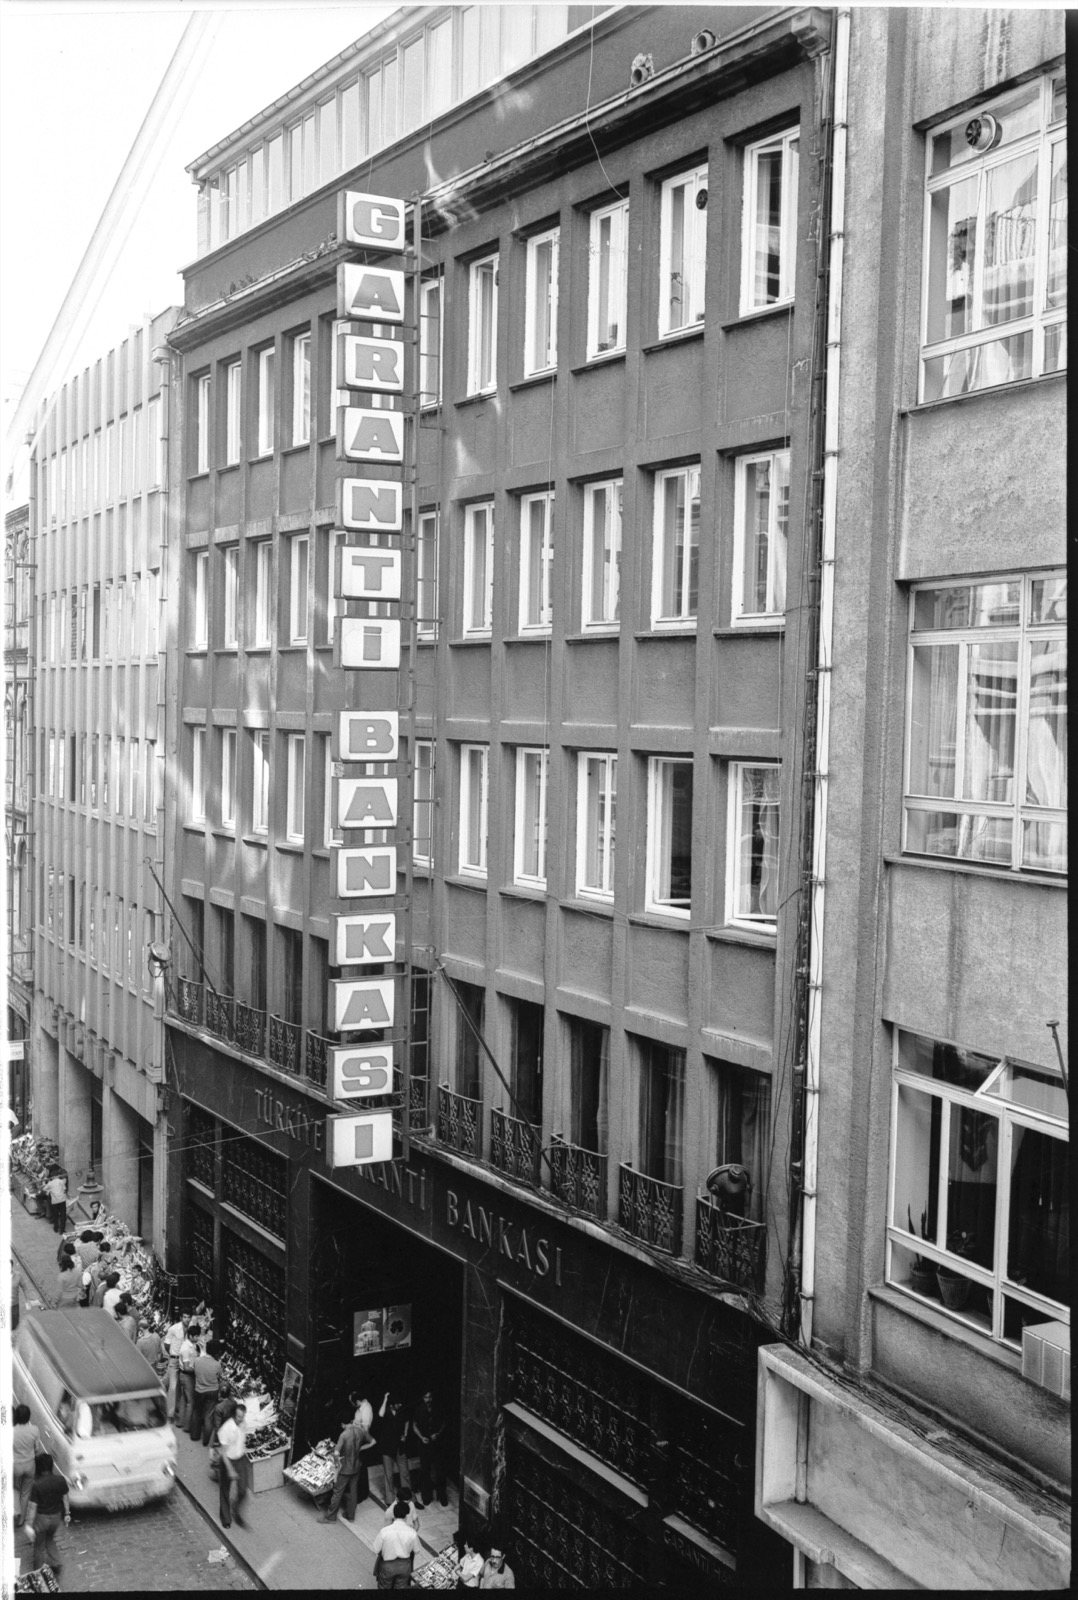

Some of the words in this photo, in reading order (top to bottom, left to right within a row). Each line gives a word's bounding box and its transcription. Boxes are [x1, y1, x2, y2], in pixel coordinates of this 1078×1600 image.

[350, 200, 400, 661] GARANTİ
[341, 718, 394, 1159] BANKASI
[447, 1190, 562, 1287] BANKASI
